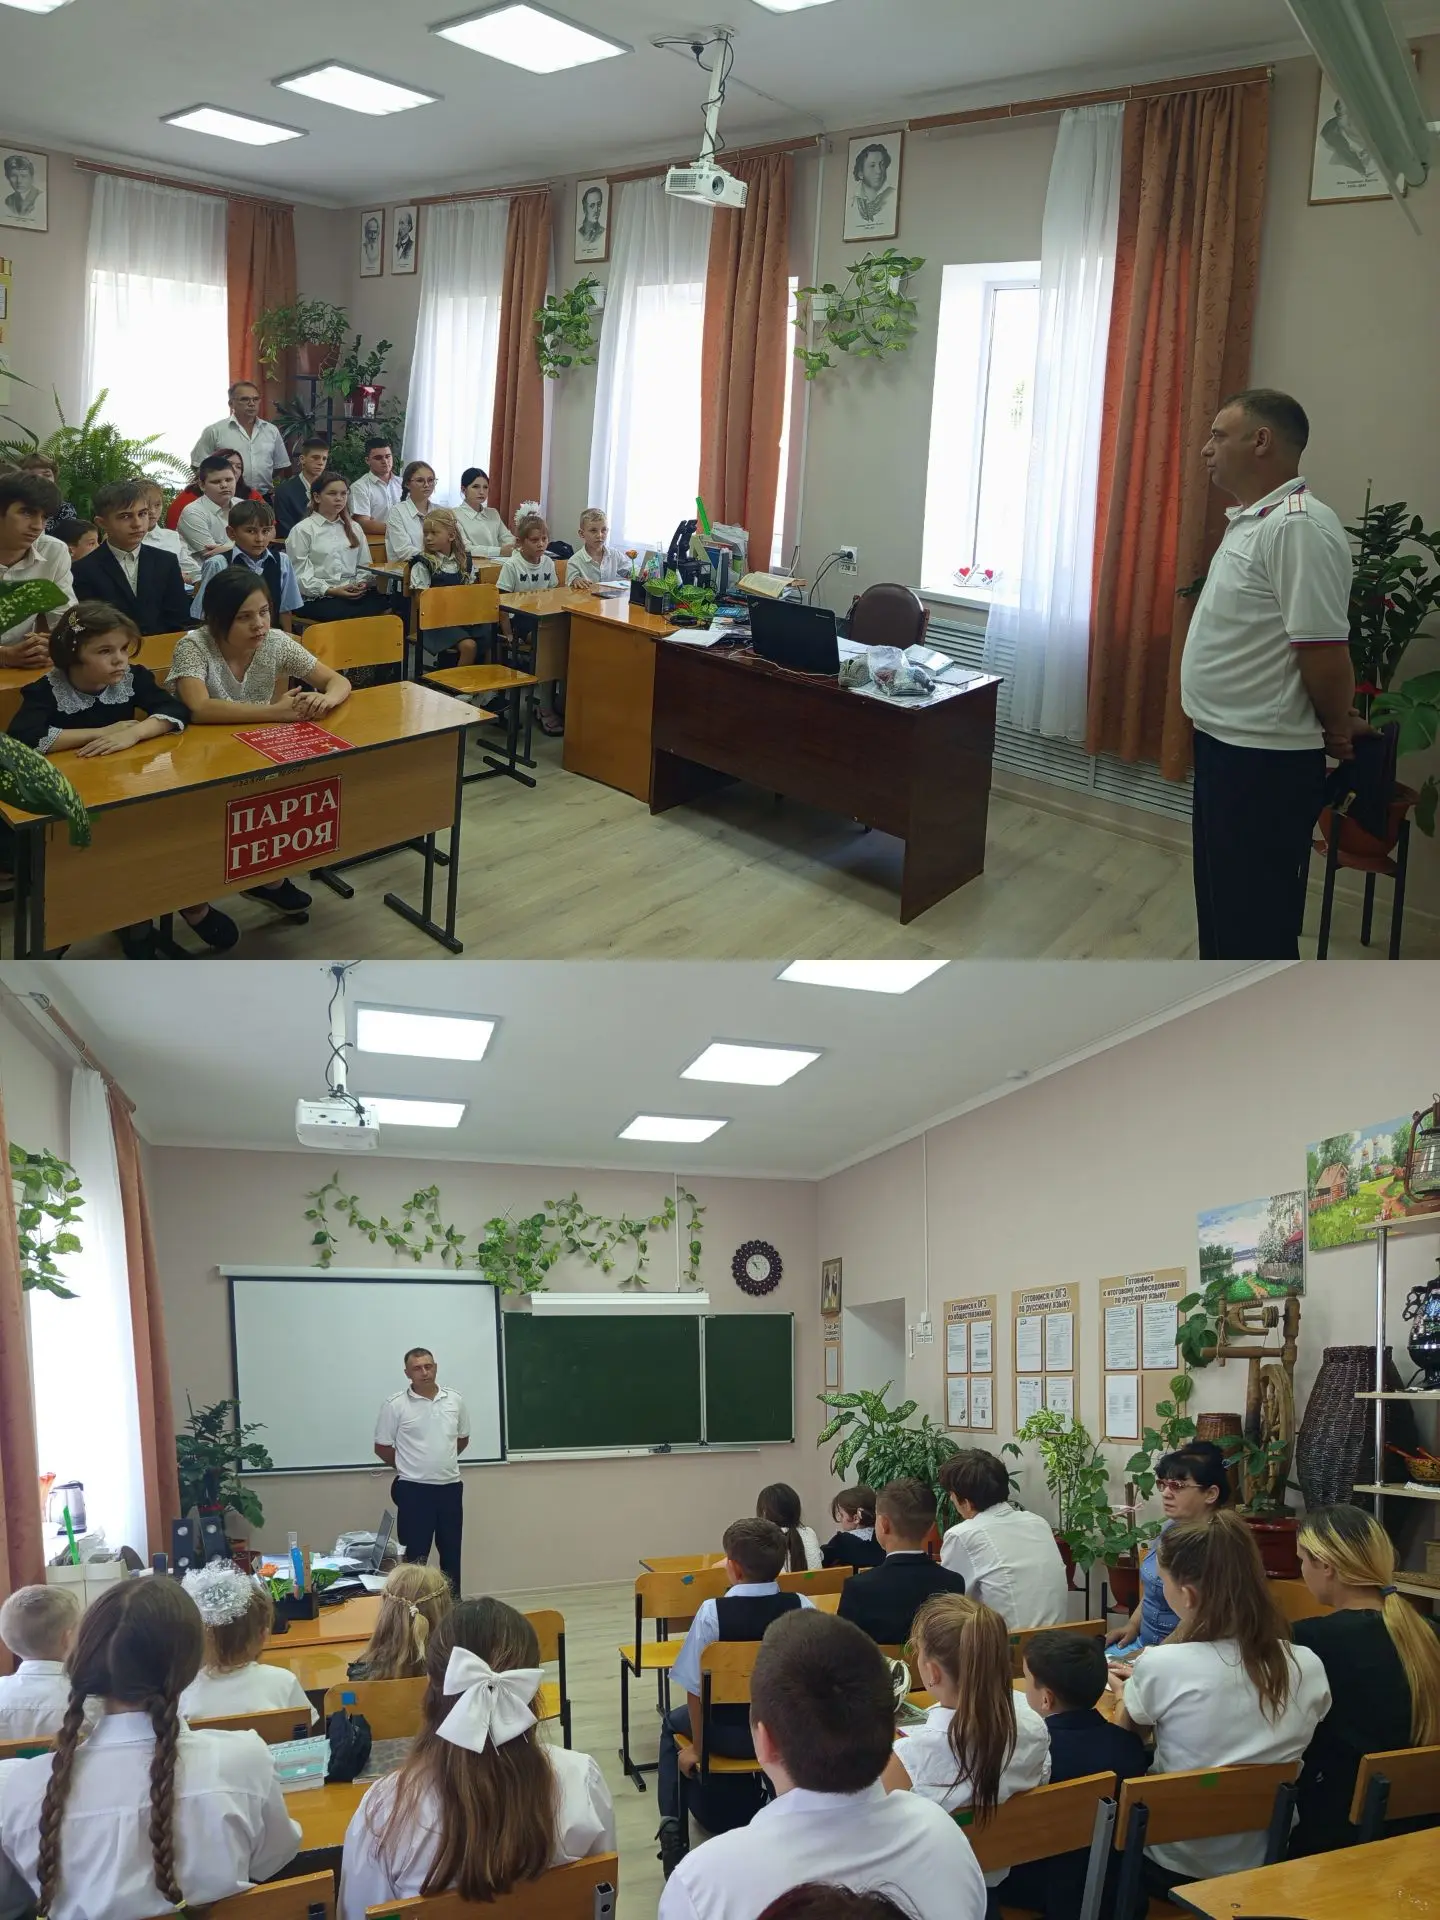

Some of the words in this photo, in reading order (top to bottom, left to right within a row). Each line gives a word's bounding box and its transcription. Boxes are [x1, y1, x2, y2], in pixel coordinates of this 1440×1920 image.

[231, 788, 337, 835] ПАРТА
[230, 821, 333, 870] ГЕРОЯ
[1125, 1275, 1154, 1285] Готовимся
[1021, 1292, 1050, 1303] Готовимся
[1055, 1287, 1067, 1299] ОГЭ
[1107, 1286, 1134, 1297] итоговому
[1135, 1280, 1180, 1293] собеседованию
[1122, 1293, 1148, 1304] русскому
[1148, 1291, 1167, 1301] языку
[1025, 1302, 1052, 1314] русскому
[1052, 1299, 1071, 1310] языку
